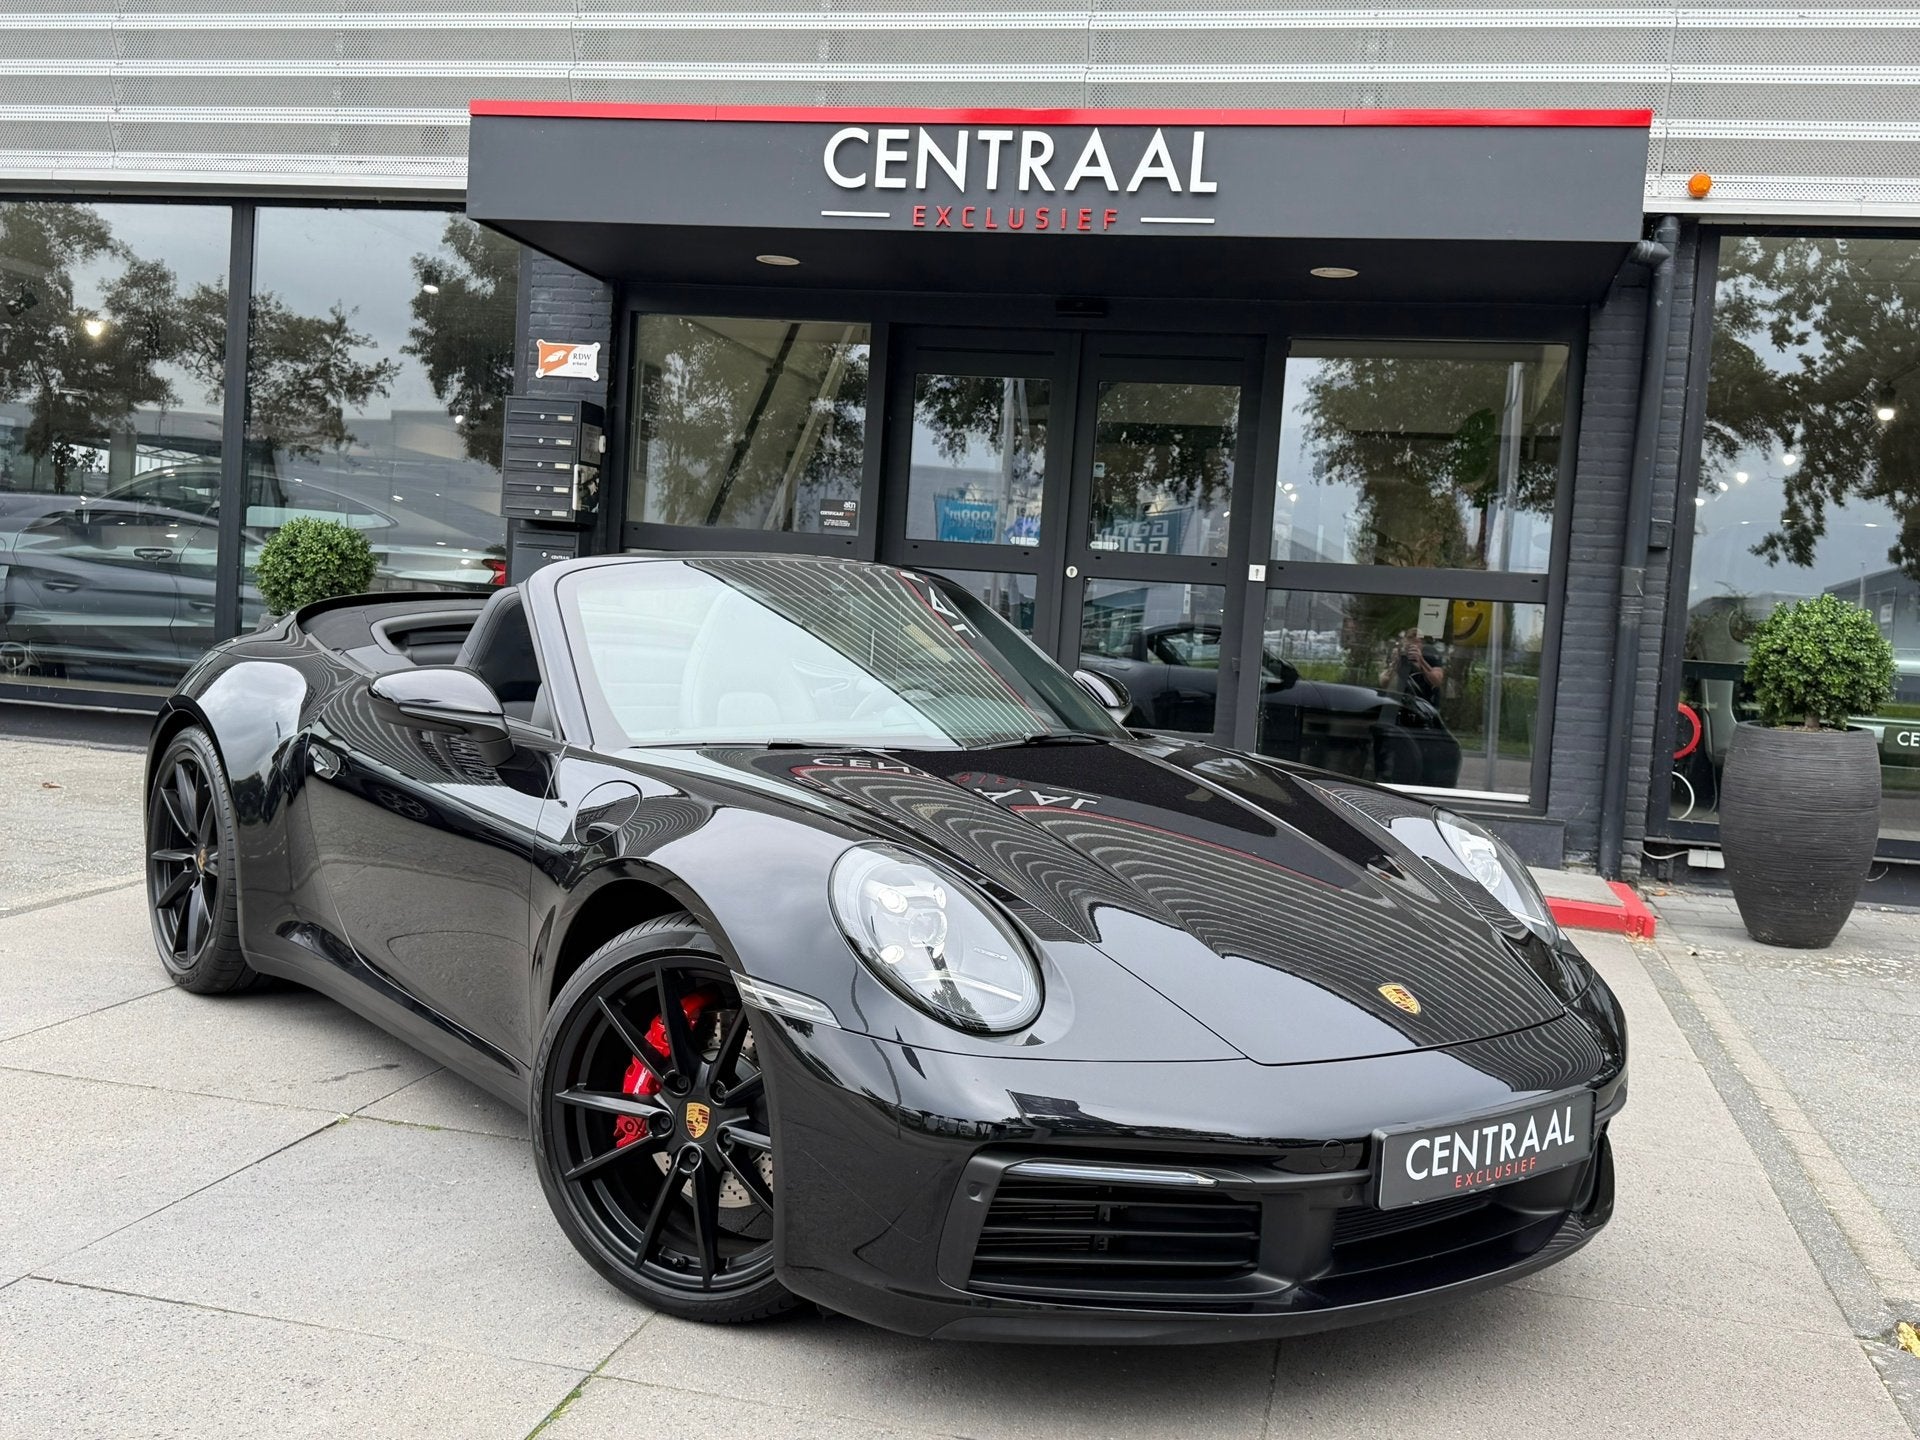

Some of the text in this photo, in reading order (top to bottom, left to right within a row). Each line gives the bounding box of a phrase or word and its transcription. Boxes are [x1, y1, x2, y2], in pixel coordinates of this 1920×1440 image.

[823, 126, 1218, 193] CENTRAAL
[913, 205, 1119, 231] EXCLUSIEF
[1405, 1105, 1576, 1181] CENTRAAL
[1455, 1156, 1537, 1189] EXCLUSIEF
